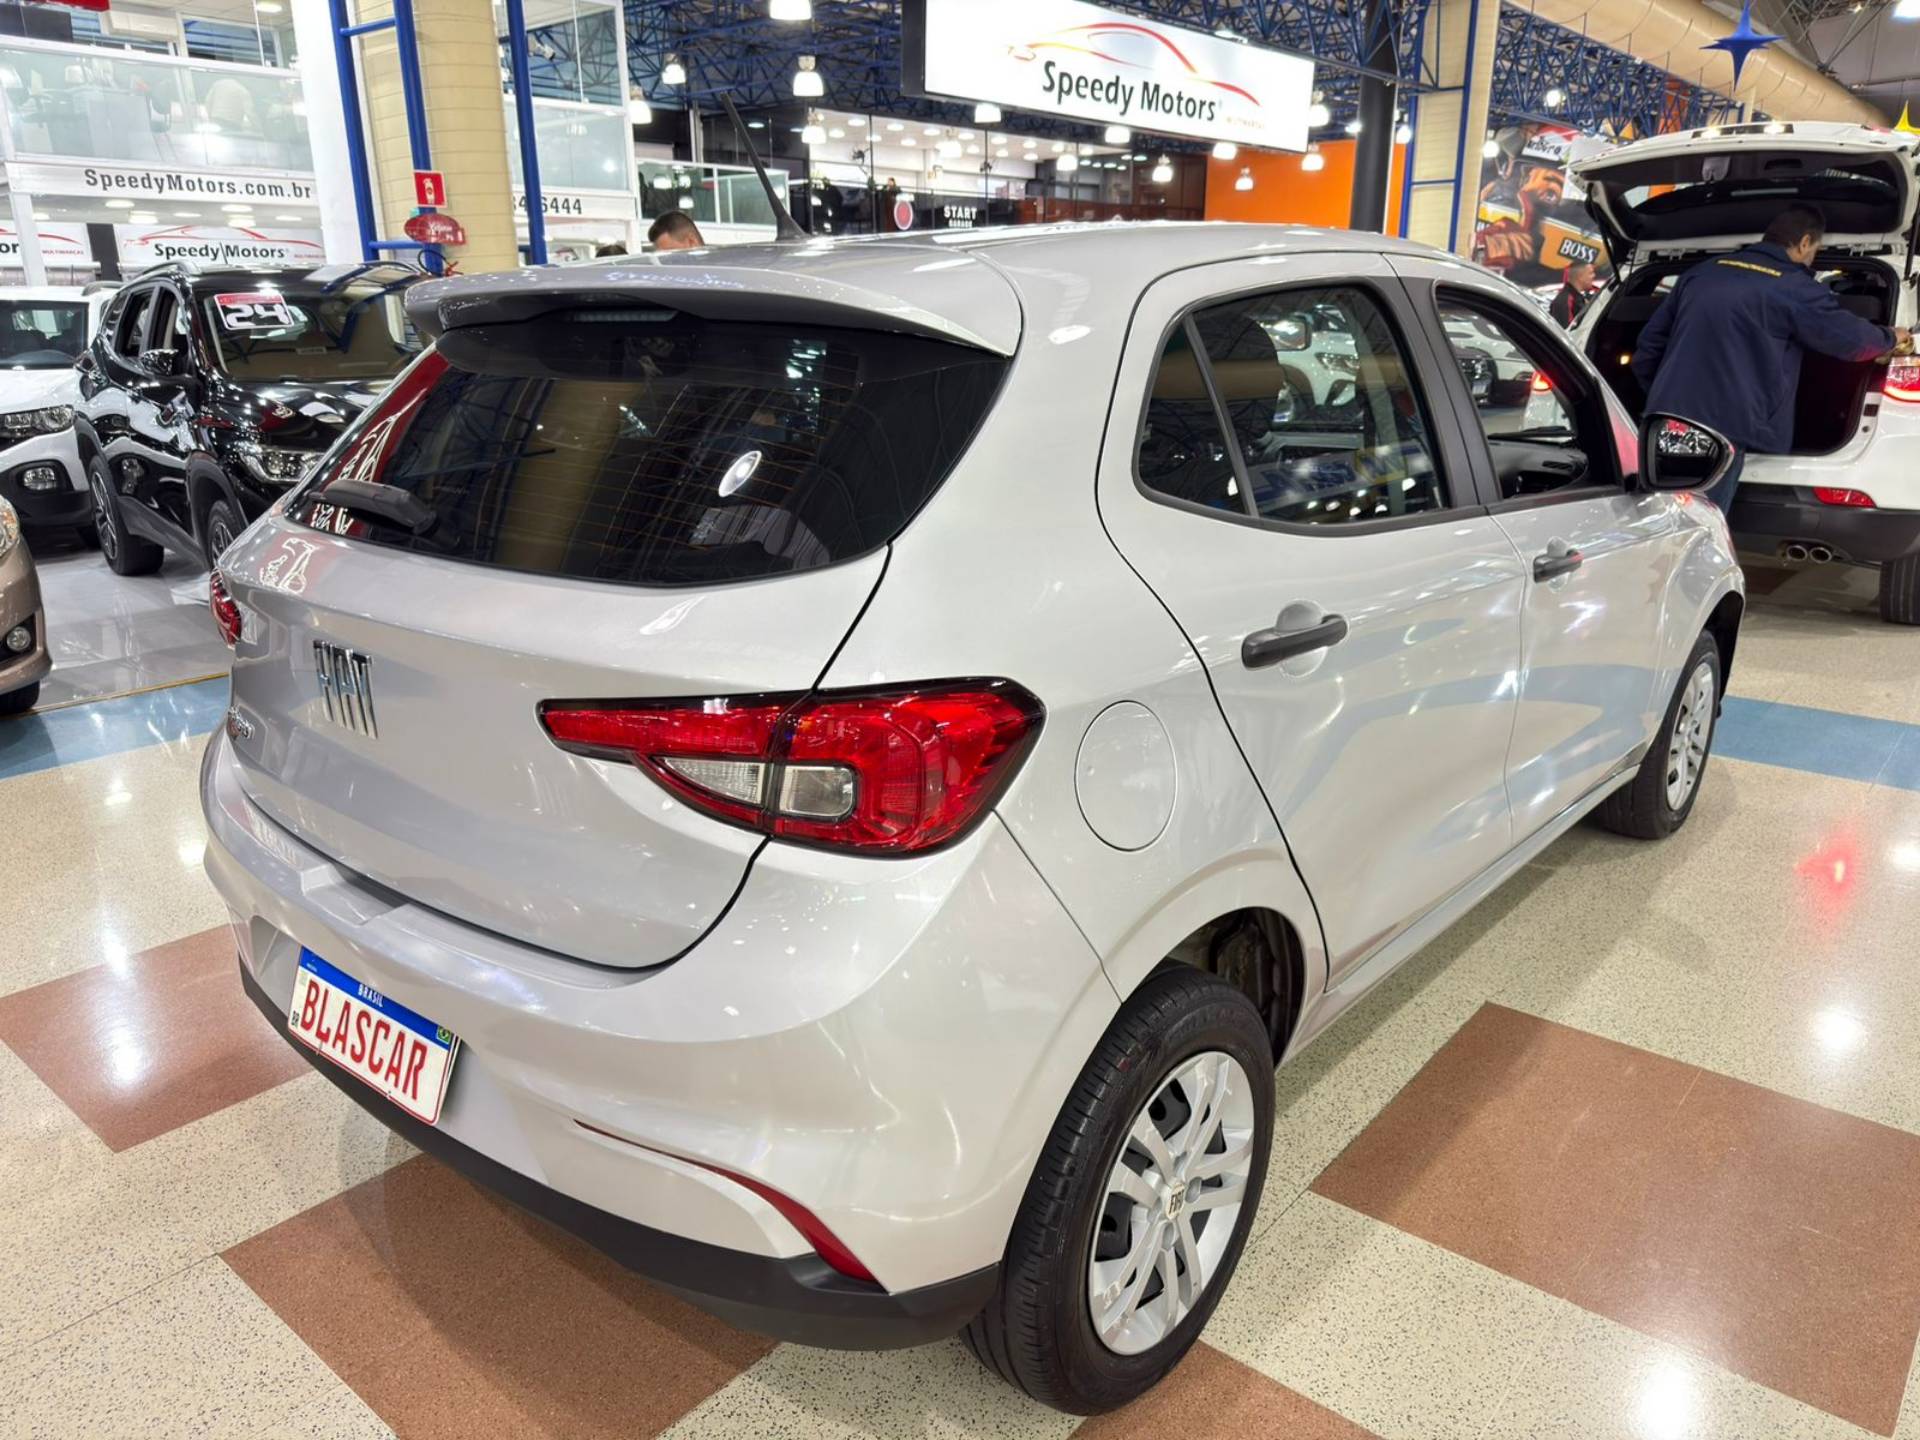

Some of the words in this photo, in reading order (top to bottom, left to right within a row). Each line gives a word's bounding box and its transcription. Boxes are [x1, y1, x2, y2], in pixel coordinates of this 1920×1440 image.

[1042, 60, 1134, 116] Speedy
[1140, 80, 1216, 122] Motors
[84, 168, 311, 199] SpeedyMotors.com.br
[943, 204, 977, 220] START
[154, 243, 220, 261] Speedy
[225, 243, 286, 259] Motors
[1560, 238, 1598, 264] BOSS
[226, 303, 290, 327] 24
[313, 639, 379, 740] FIAT
[357, 983, 384, 1008] BRASIL
[300, 979, 428, 1101] BLASCAR
